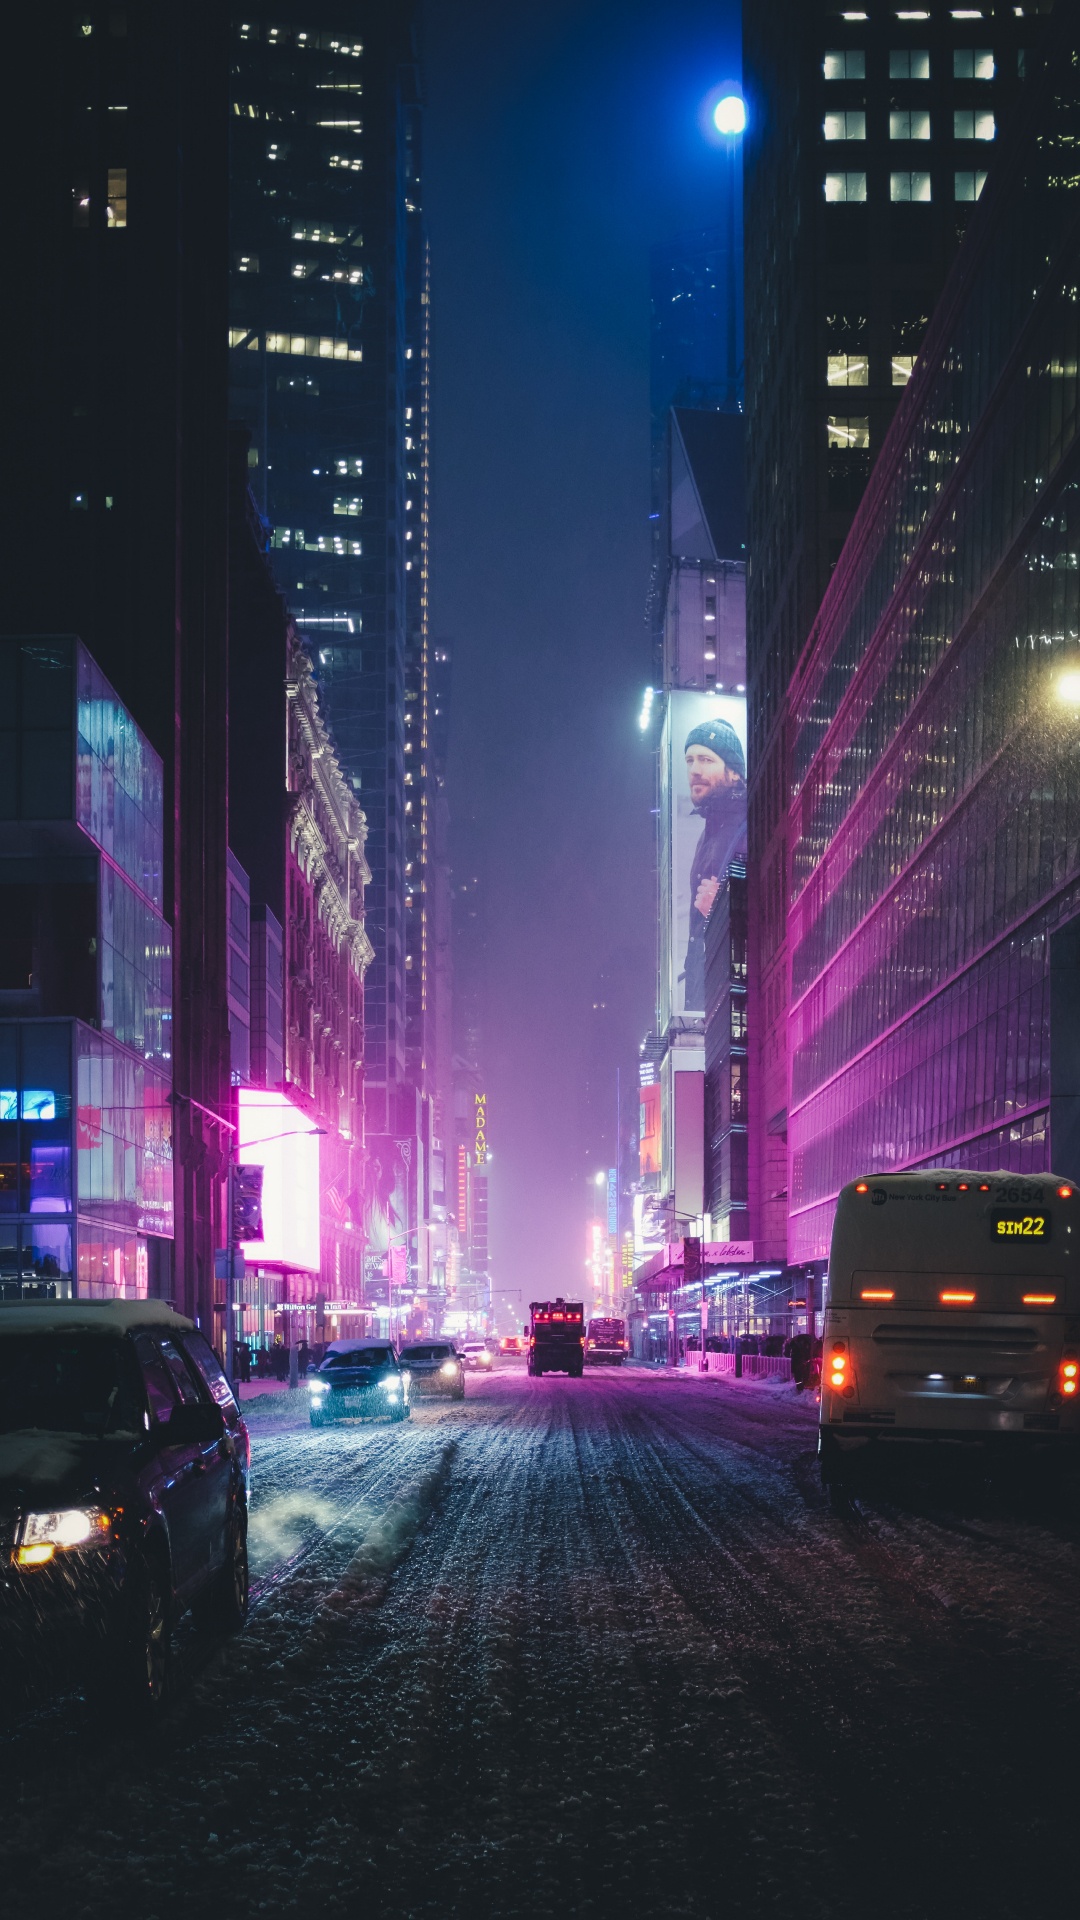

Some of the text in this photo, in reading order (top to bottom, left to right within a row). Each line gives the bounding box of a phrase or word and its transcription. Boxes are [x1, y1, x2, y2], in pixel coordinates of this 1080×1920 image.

[474, 1093, 487, 1164] MADAME
[608, 1168, 617, 1182] NEW
[925, 1194, 940, 1202] City
[995, 1187, 1045, 1203] 2654
[997, 1216, 1045, 1236] SIM22
